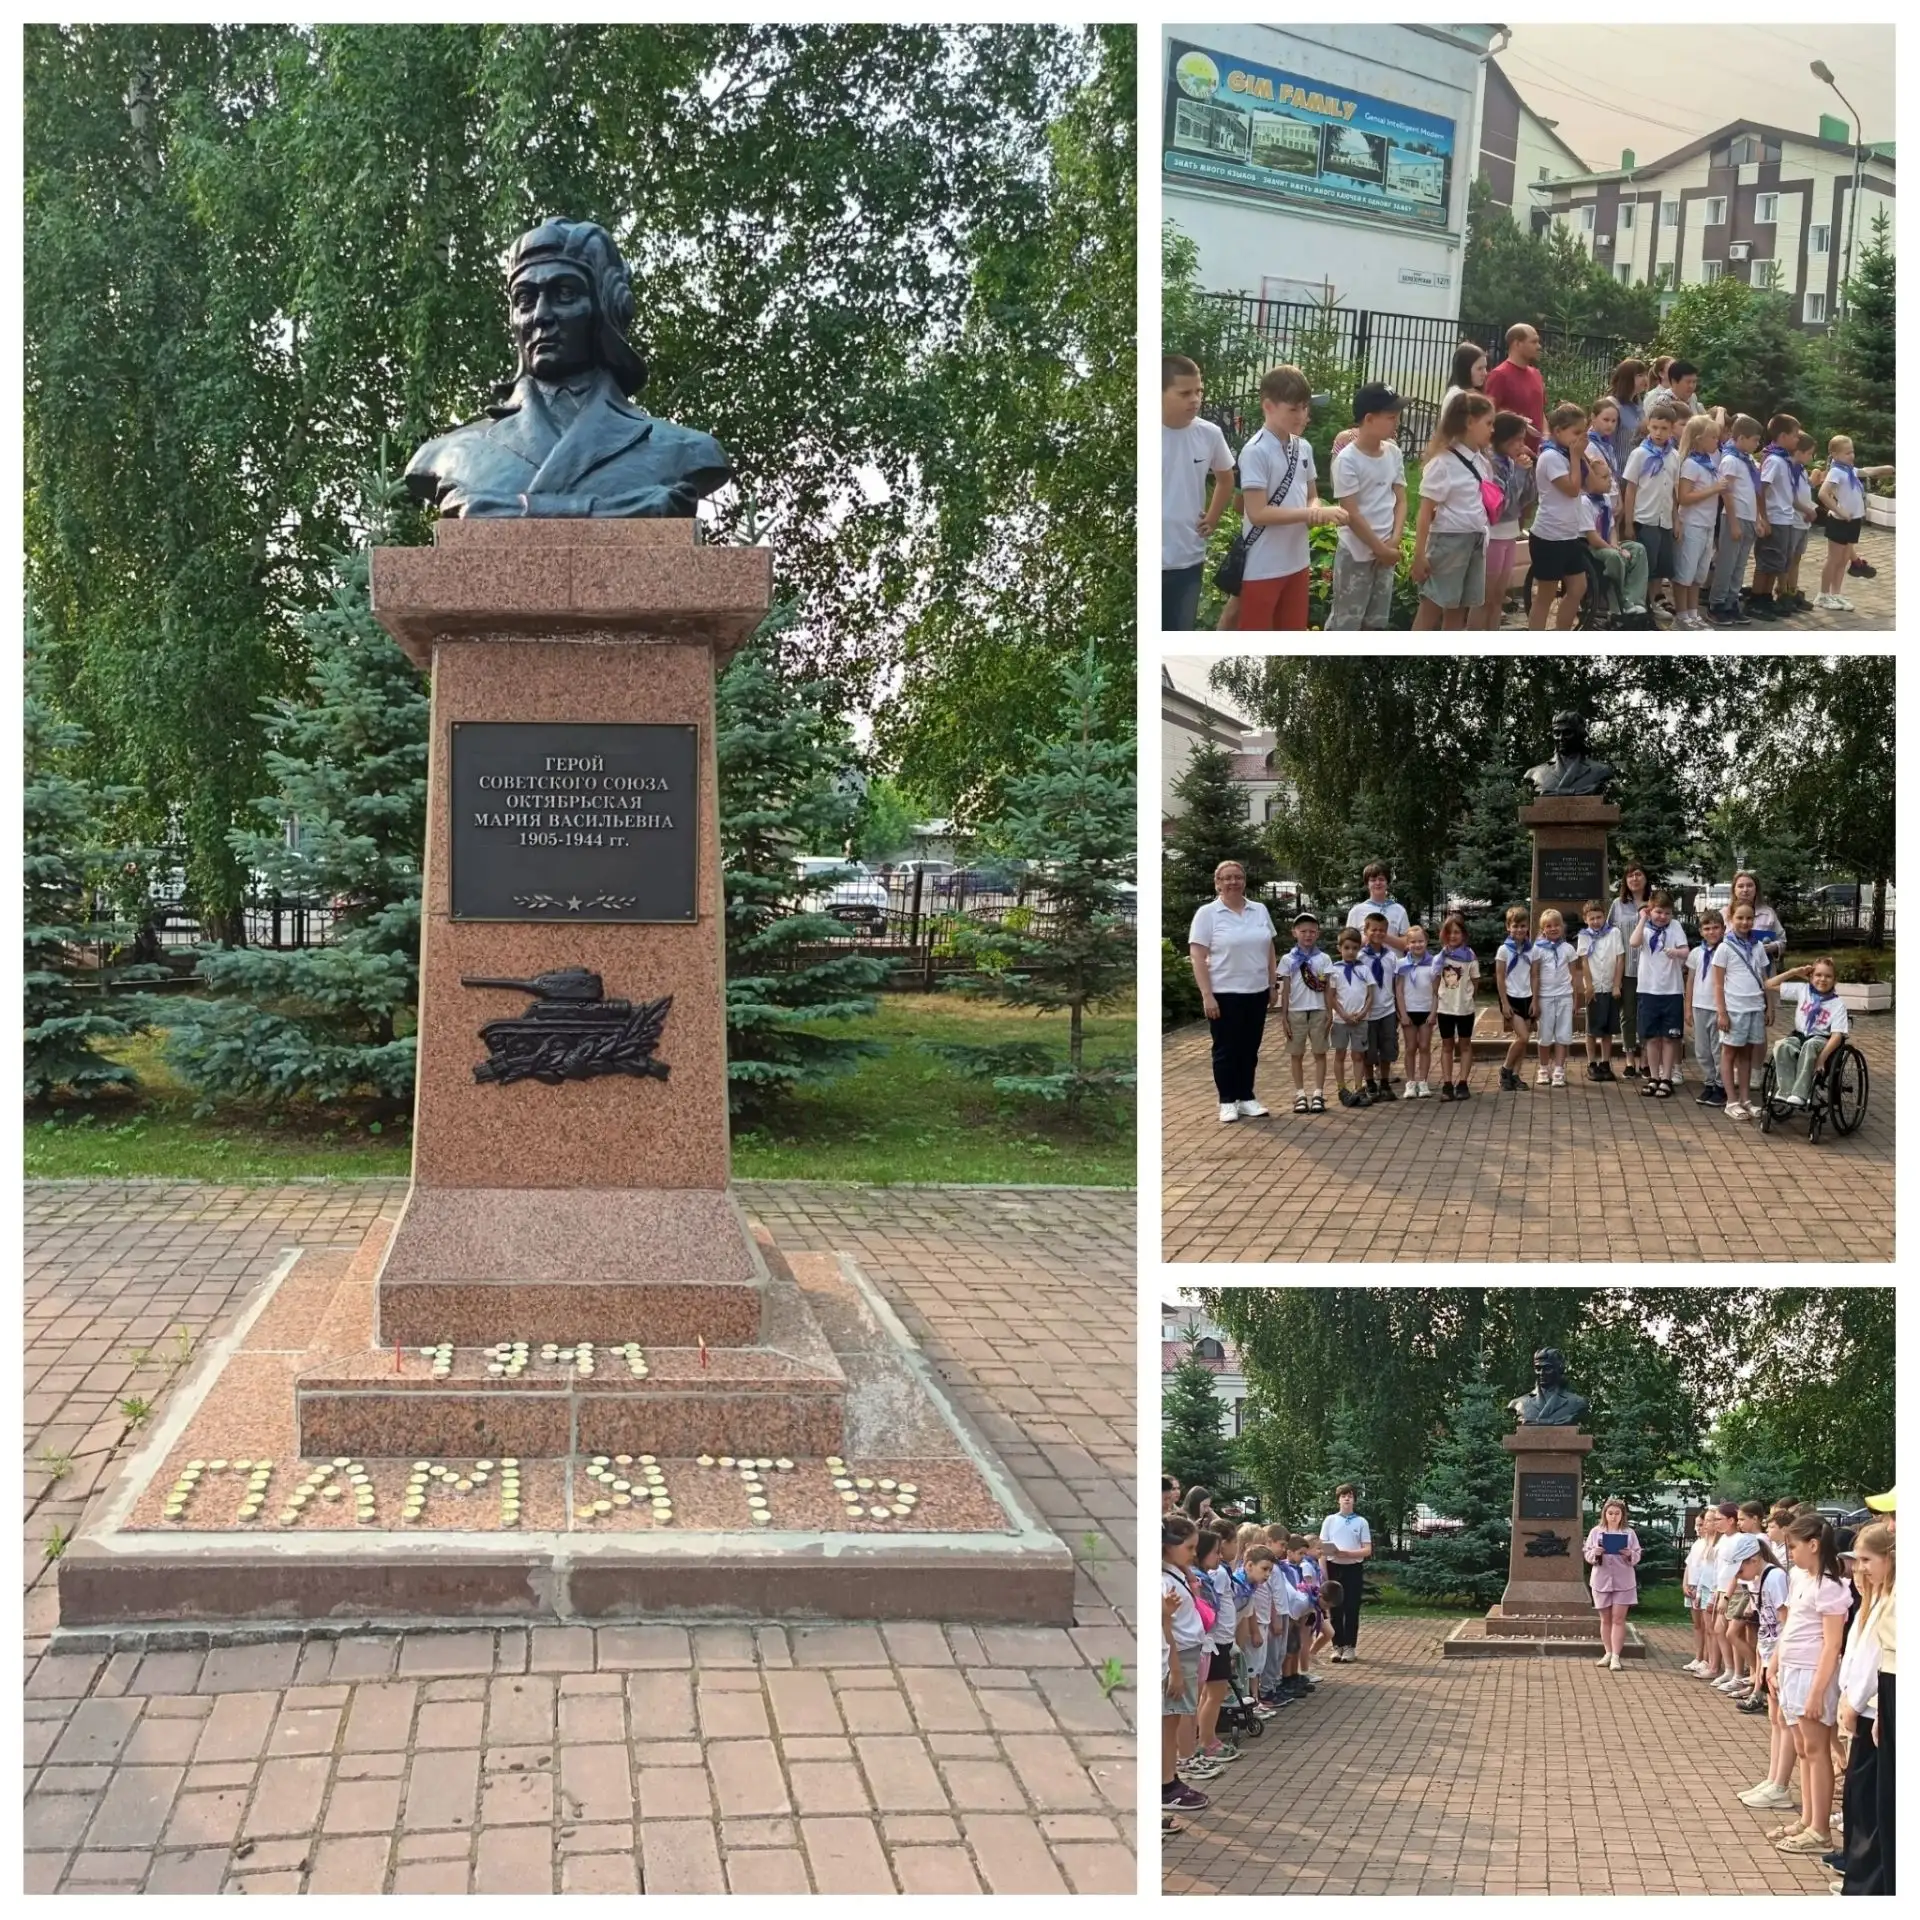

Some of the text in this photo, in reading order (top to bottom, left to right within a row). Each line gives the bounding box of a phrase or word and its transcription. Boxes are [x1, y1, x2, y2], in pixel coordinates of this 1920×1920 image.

[1227, 70, 1275, 101] GIM
[1279, 83, 1358, 121] FAMILY
[1420, 127, 1445, 139] Modern
[1174, 158, 1198, 169] ЗНАТЬ
[1199, 164, 1225, 175] МНОГО
[1227, 169, 1256, 181] ЯЗЫКОВ
[1263, 176, 1288, 187] ЗНАЧИТ
[545, 755, 604, 771] ГЕРОЙ
[479, 776, 669, 791] СОВЕТСКОГО СОЮЗА
[506, 795, 641, 809] ОКТЯБРЬСКАЯ
[474, 813, 674, 829] МАРИЯ ВАСИЛЬЕВНА
[519, 833, 630, 847] 1905-1944 гг.
[420, 1342, 649, 1381] 1941
[162, 1452, 918, 1527] ПАМЯТЬ
